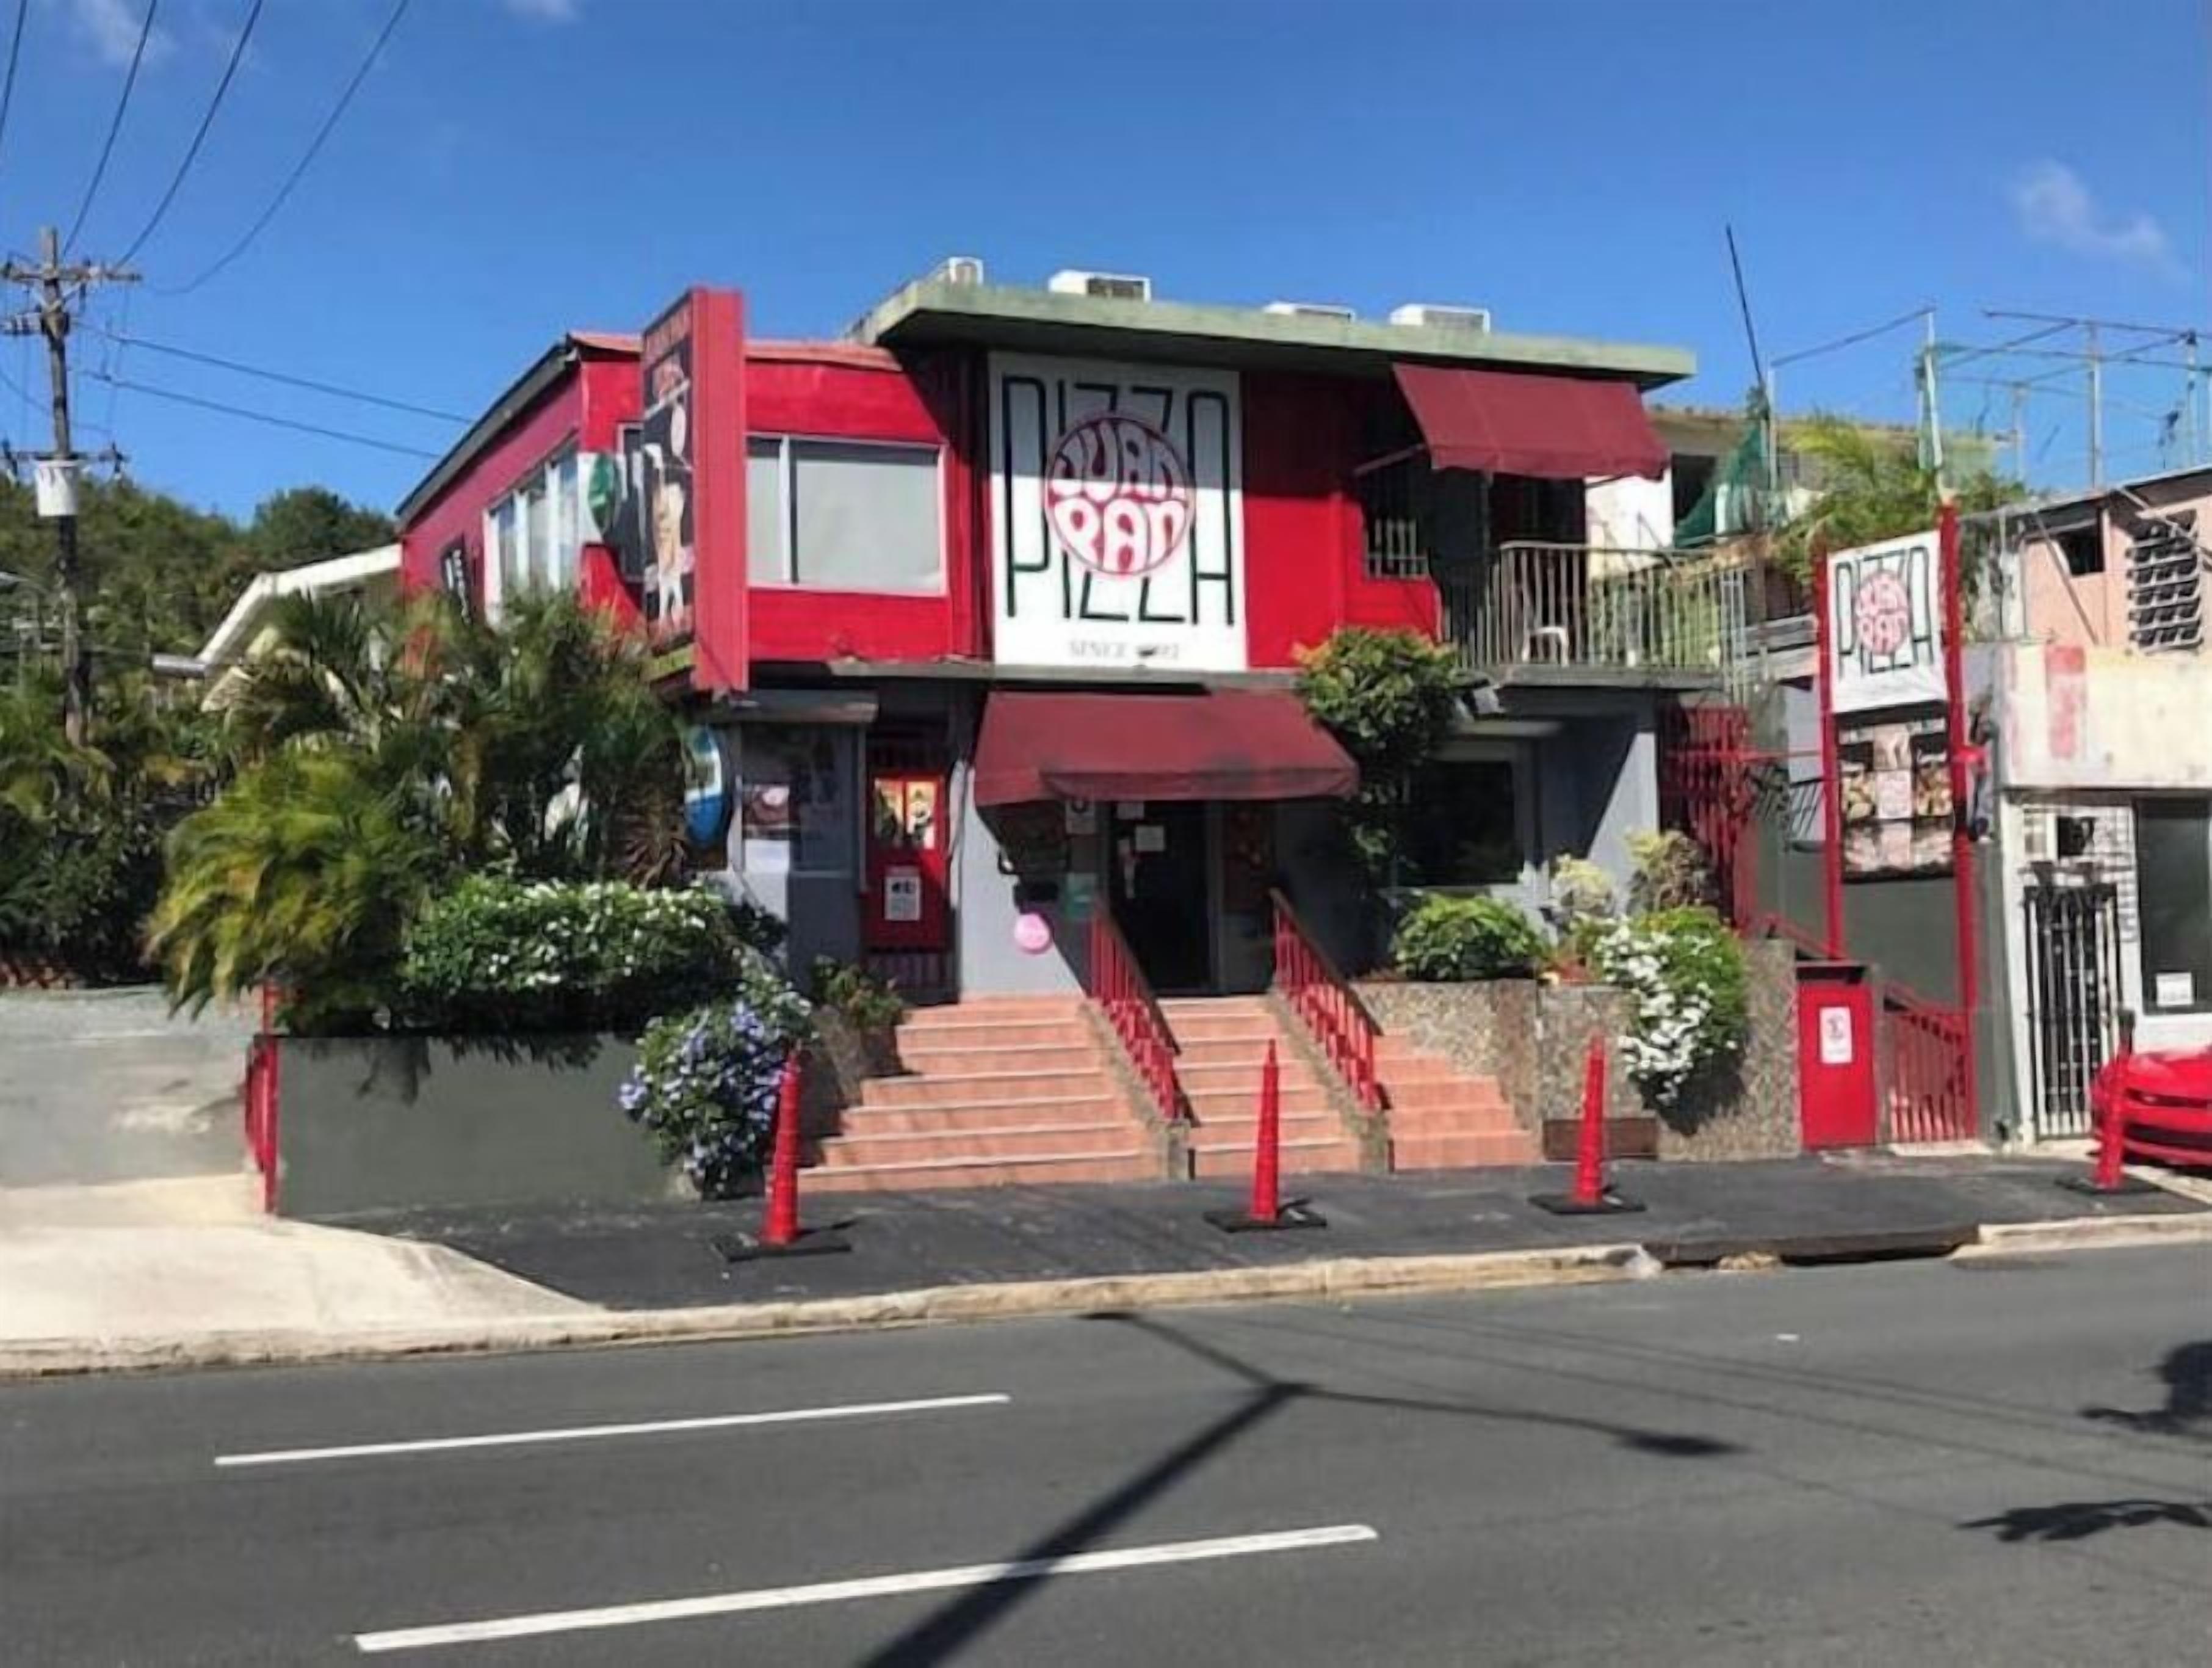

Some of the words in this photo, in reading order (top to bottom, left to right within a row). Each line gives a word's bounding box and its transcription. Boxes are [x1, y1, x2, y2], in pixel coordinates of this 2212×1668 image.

[1003, 373, 1234, 626] PIZZA
[1050, 419, 1188, 502] JUAN
[1052, 496, 1188, 573] PAN
[1835, 545, 1934, 679] PIZZA
